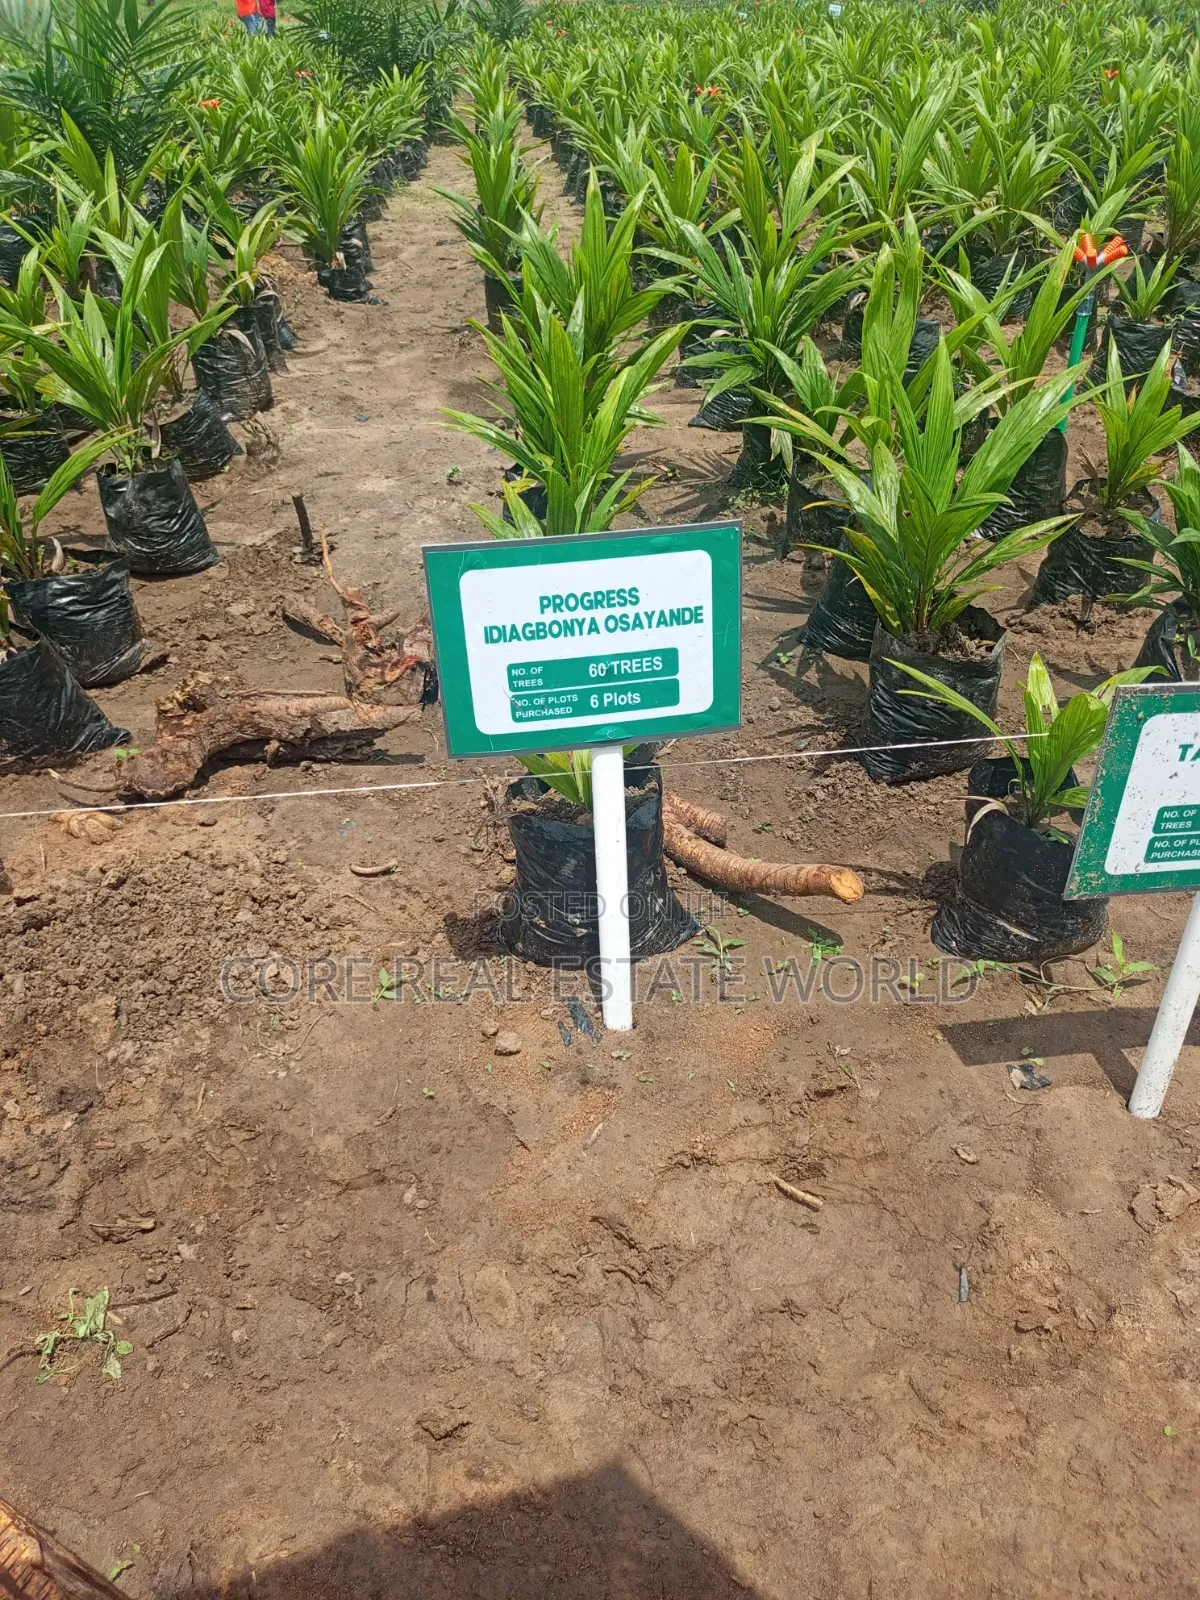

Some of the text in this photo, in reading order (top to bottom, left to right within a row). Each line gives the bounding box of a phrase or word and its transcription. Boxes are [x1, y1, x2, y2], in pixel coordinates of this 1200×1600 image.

[539, 587, 640, 614] PROGRESS
[484, 606, 704, 644] IDIAGBONYA OSAYANDE
[511, 667, 543, 676] NO. OF
[589, 656, 663, 677] 60 TREES
[513, 679, 543, 687] TREES
[511, 699, 531, 707] NO.
[548, 695, 578, 704] PLOTS
[590, 691, 641, 708] 6 Plots
[516, 707, 572, 718] PURCHASED
[1162, 809, 1197, 819] NO. OF
[1160, 821, 1192, 830] TREES
